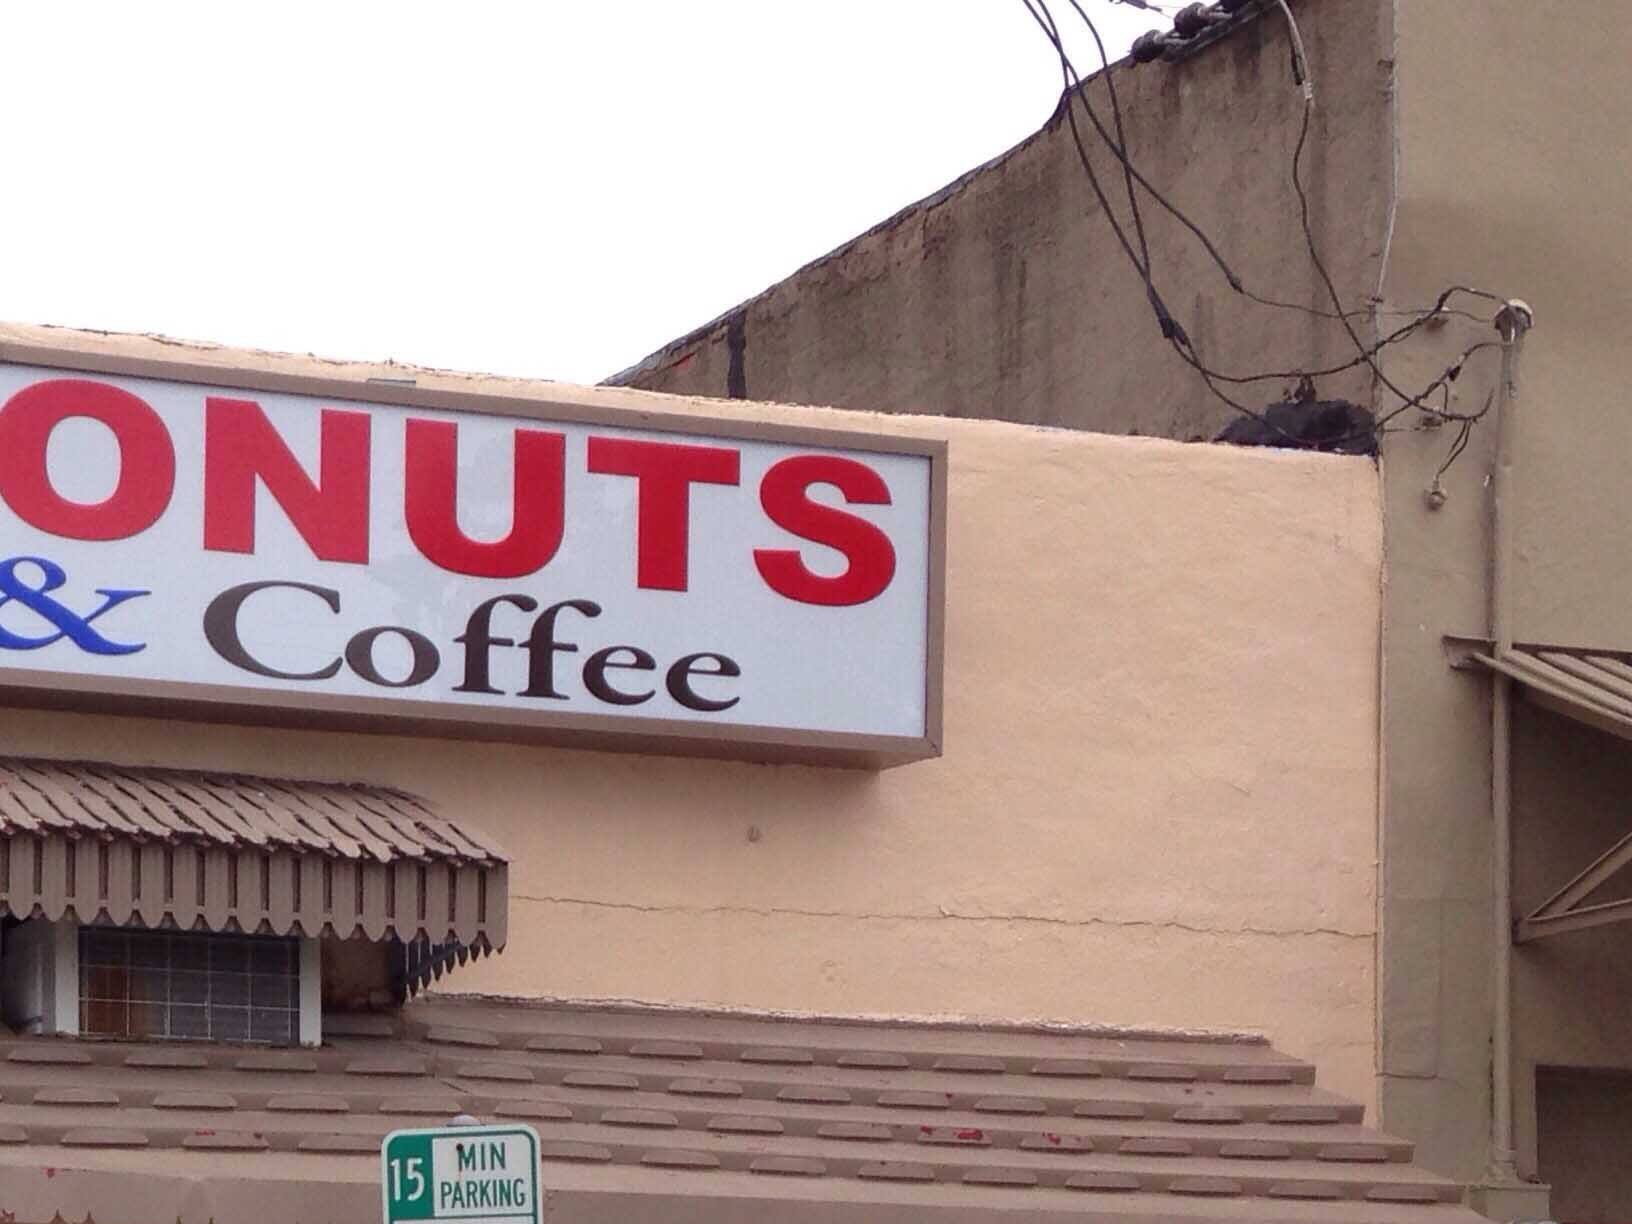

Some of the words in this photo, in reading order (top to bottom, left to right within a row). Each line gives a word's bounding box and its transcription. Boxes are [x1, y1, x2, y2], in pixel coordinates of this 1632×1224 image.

[204, 580, 742, 712] Coffee
[390, 1157, 425, 1201] 15
[458, 1142, 506, 1172] MIN
[441, 1179, 526, 1209] PARKING
